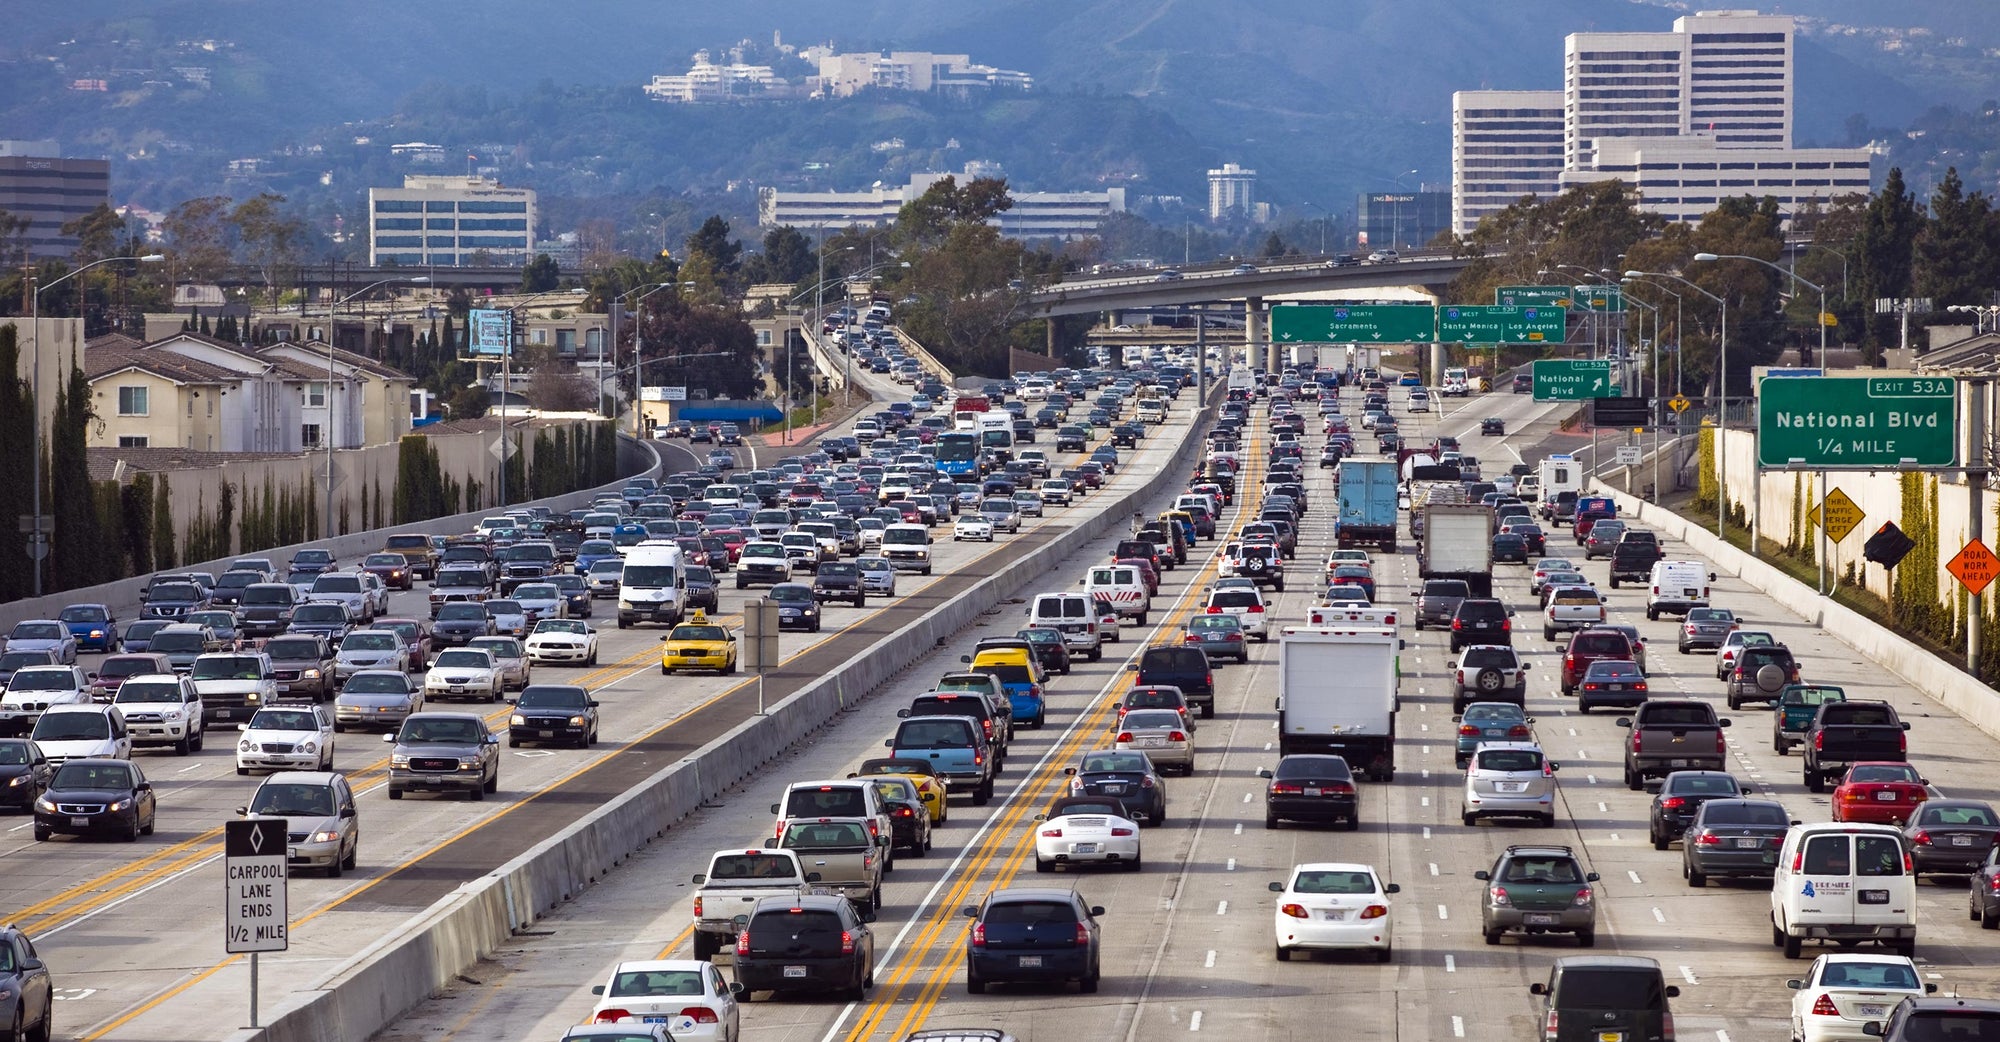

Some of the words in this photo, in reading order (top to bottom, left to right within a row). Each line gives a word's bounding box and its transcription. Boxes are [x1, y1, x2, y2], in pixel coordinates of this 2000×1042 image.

[1876, 382, 1904, 392] EXIT
[1912, 381, 1947, 393] 53A
[1777, 412, 1874, 428] National
[1888, 412, 1937, 428] Blvd
[1817, 438, 1842, 455] 1/4
[1853, 441, 1896, 453] MILE
[1963, 551, 1988, 560] ROAD
[1963, 562, 1988, 570] WORK
[1962, 572, 1991, 581] AHEAD
[230, 865, 284, 880] CARPOOL
[242, 884, 272, 898] LANE
[242, 904, 272, 918] ENDS
[230, 926, 248, 942] 1/2
[256, 925, 284, 940] MILE
